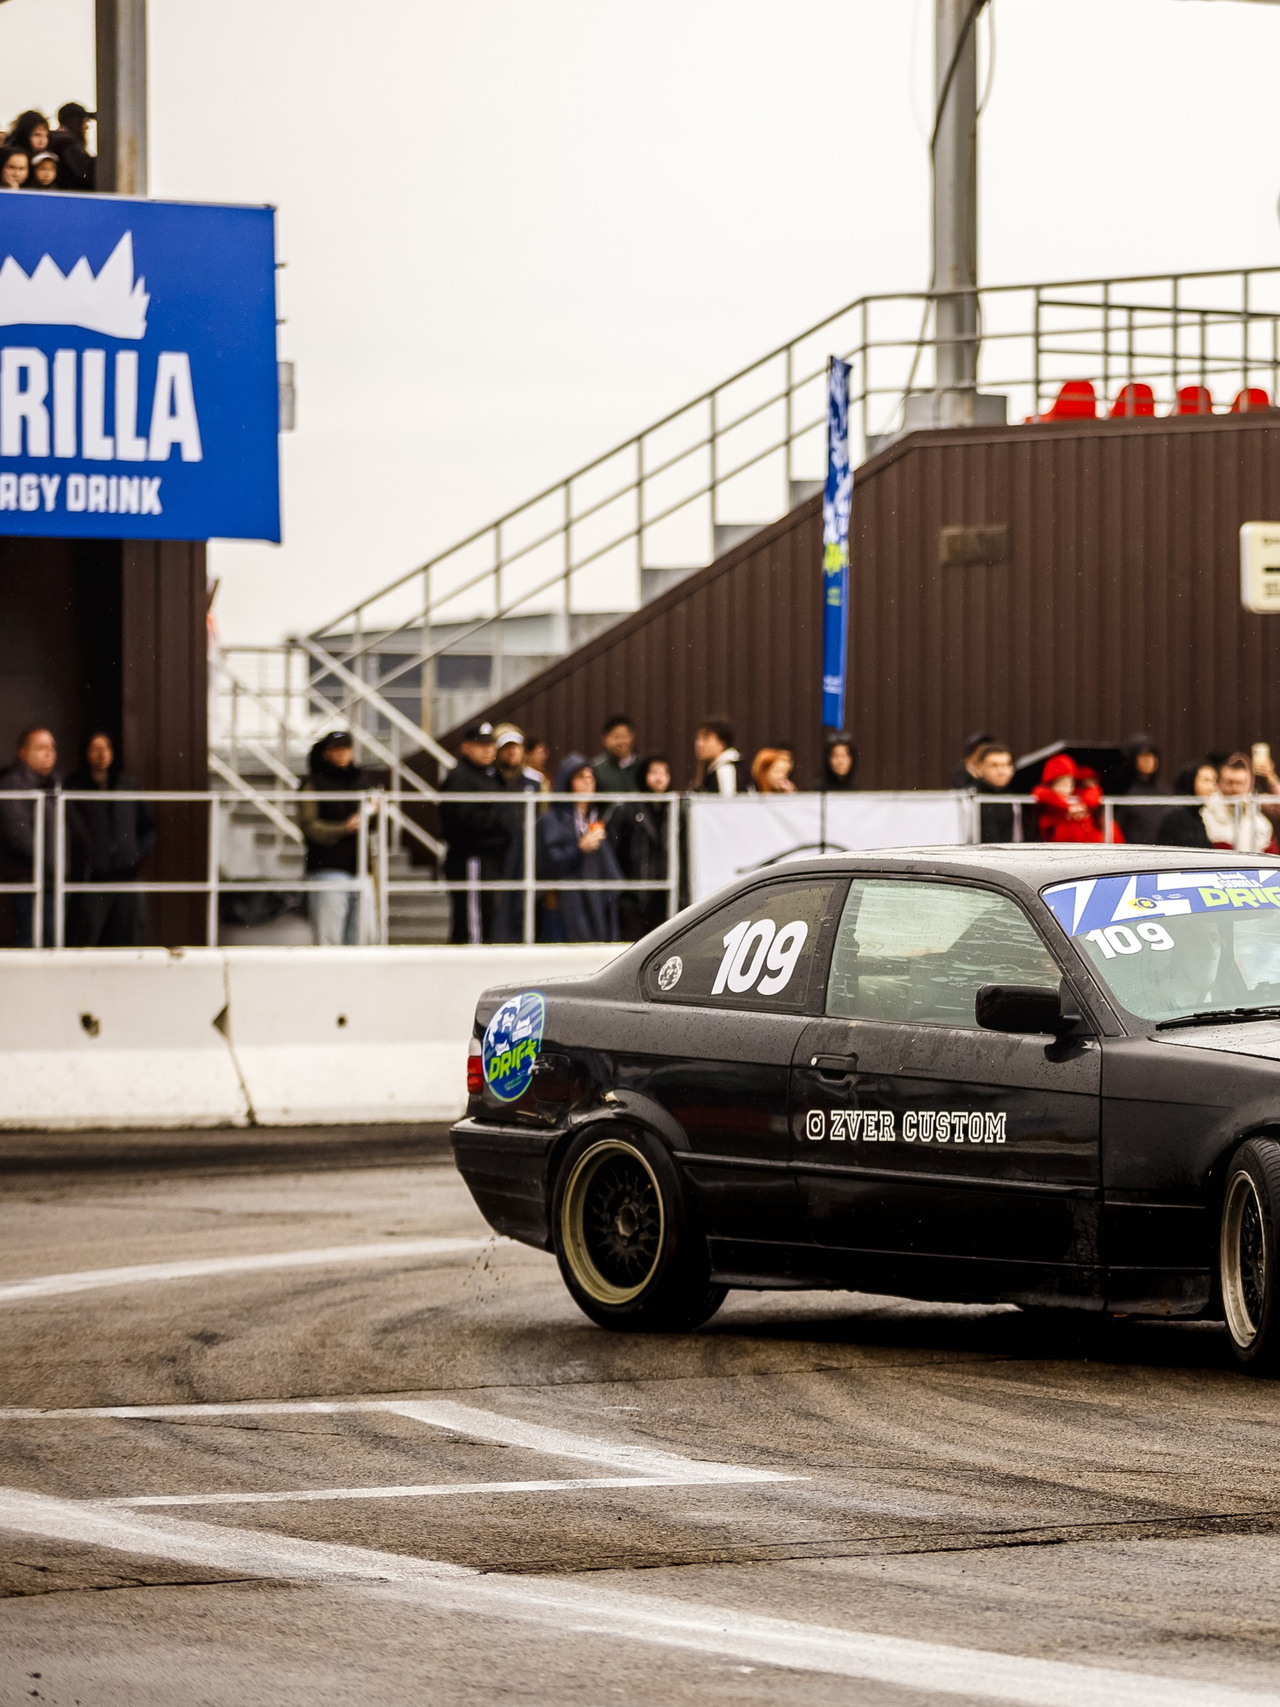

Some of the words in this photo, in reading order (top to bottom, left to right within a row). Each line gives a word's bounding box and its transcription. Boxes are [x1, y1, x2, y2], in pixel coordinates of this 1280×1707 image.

[66, 474, 163, 516] DRINK
[711, 919, 808, 996] 109
[1085, 922, 1175, 960] 109
[488, 1038, 538, 1083] DRIFT
[829, 1109, 896, 1142] ZVER
[902, 1110, 1007, 1144] CUSTOM
